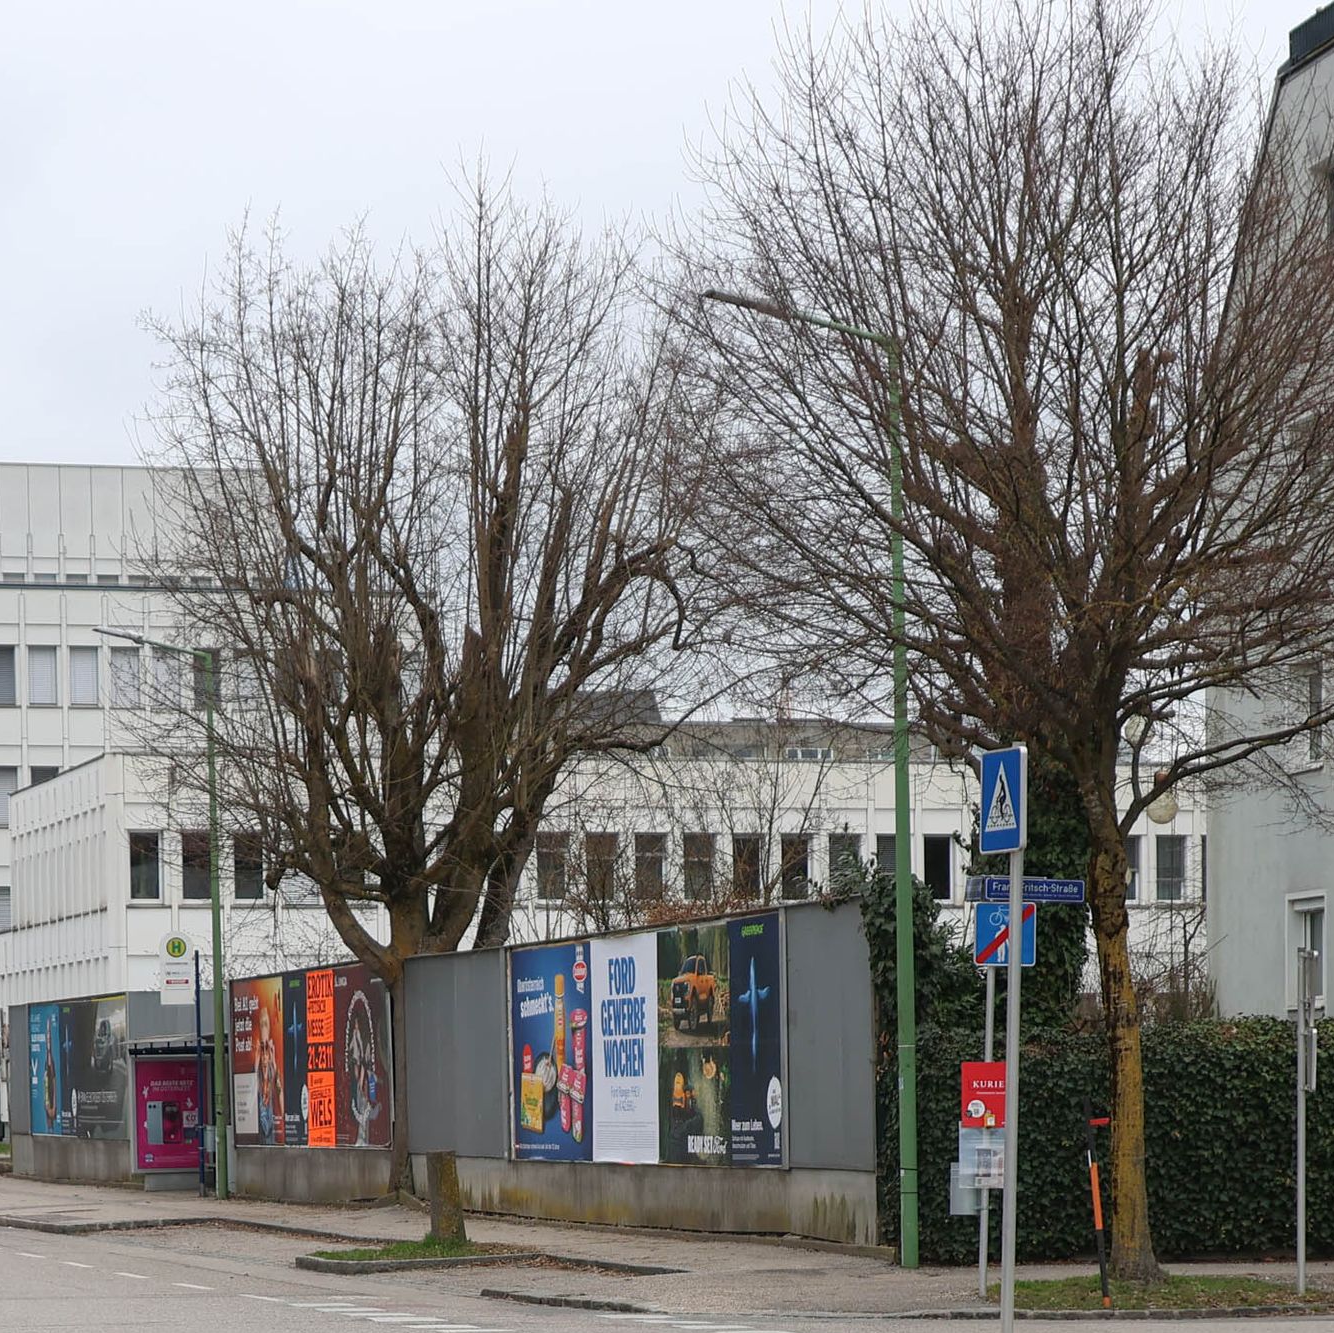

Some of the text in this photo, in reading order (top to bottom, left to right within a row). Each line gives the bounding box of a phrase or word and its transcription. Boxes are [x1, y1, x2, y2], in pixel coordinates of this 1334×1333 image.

[992, 881, 1079, 893] FranFritsch-Straße
[307, 973, 333, 999] EROTIK
[608, 956, 636, 995] FORD
[601, 997, 646, 1037] GEWERBE
[603, 1038, 644, 1077] WOCHEN
[972, 1080, 1005, 1089] KURIE
[310, 1098, 333, 1128] WELS
